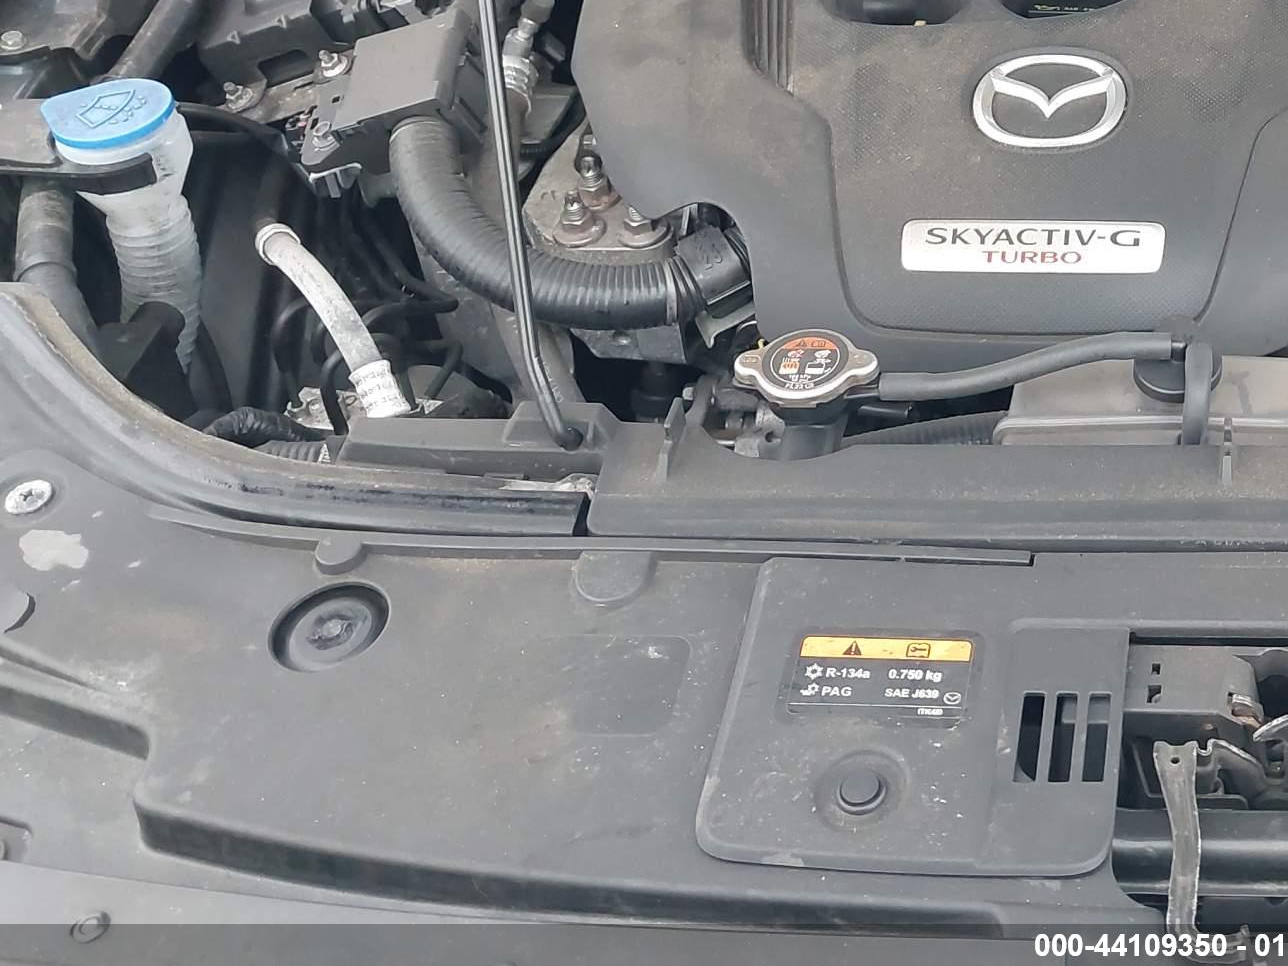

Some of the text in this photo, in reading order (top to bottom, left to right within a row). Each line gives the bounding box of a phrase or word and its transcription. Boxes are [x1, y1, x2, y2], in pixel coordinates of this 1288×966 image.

[925, 227, 1141, 247] SKYACTIV-G
[982, 250, 1082, 264] TURBO
[825, 667, 943, 683] R-134a 0.750 kg
[821, 686, 940, 699] PAG SAE J639
